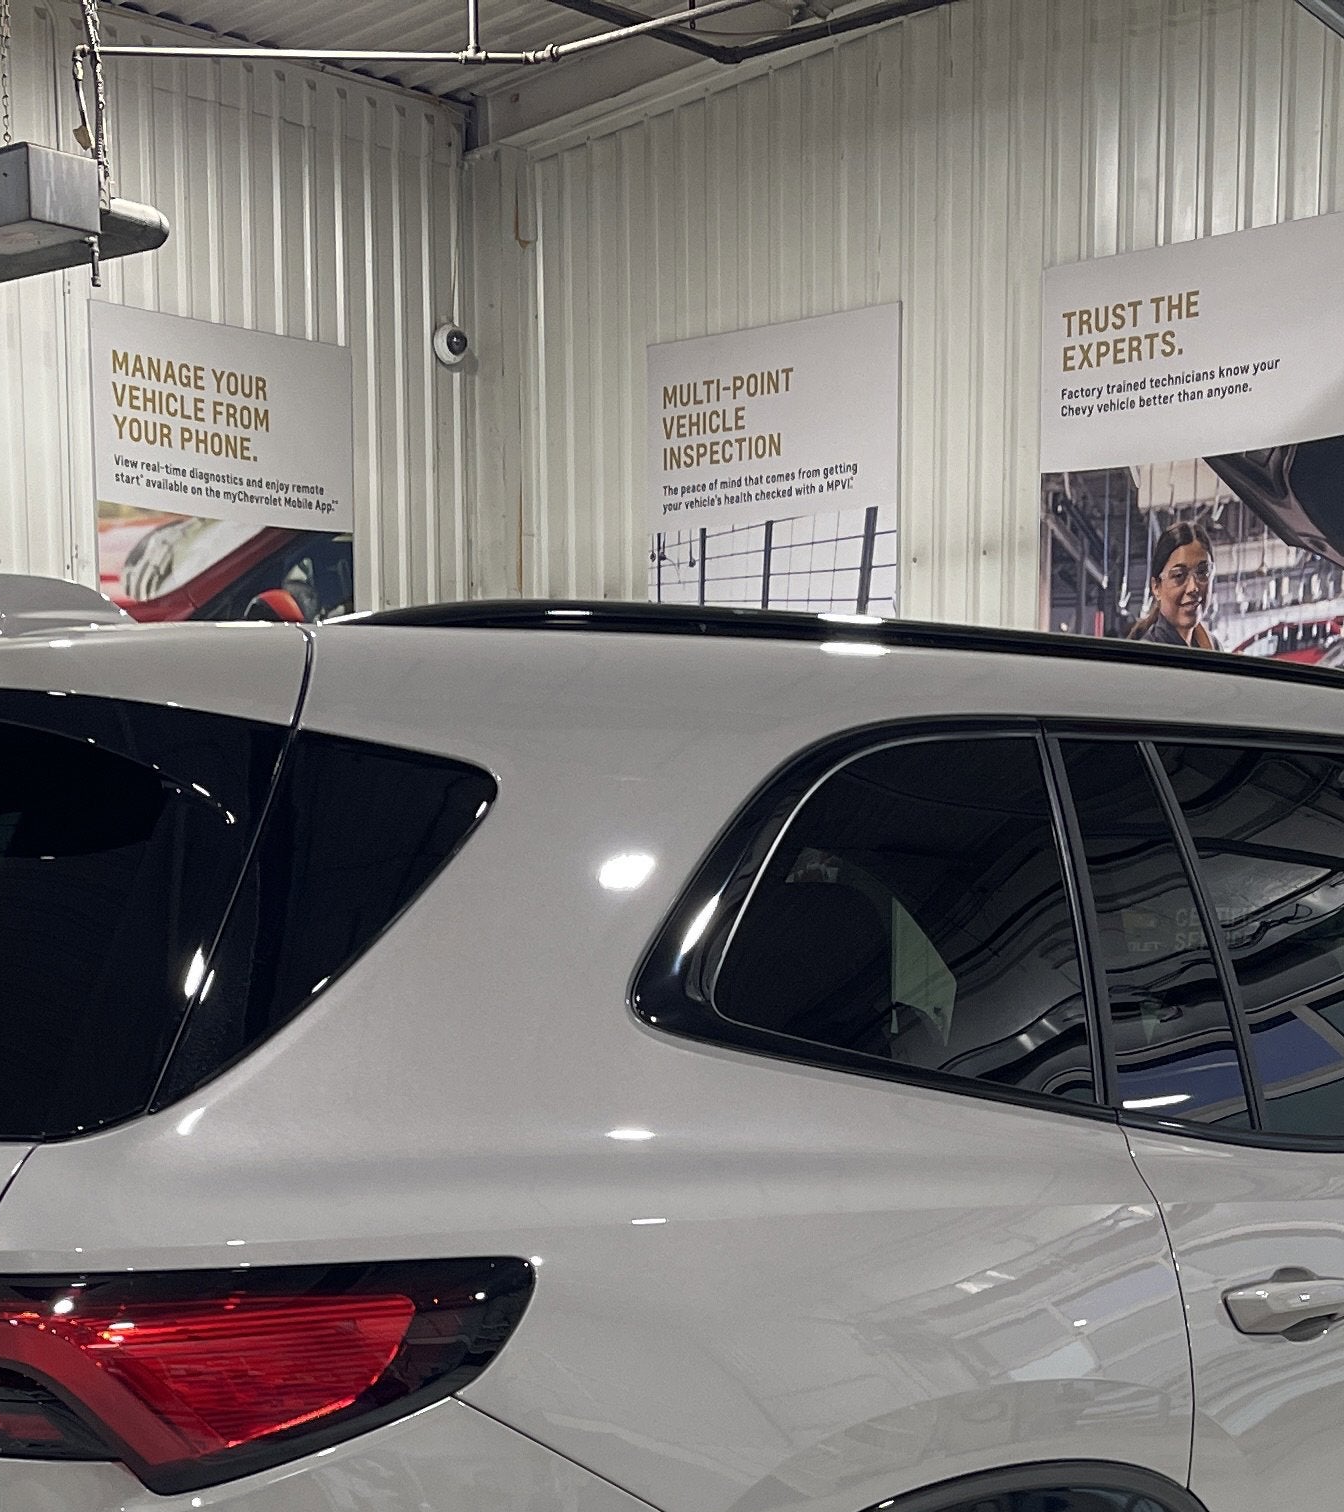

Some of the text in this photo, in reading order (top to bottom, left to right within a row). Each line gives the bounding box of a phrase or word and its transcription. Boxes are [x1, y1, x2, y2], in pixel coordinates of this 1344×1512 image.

[1062, 290, 1199, 336] TRUST THE
[1062, 331, 1183, 371] EXPERTS.
[111, 350, 267, 400] MANAGE YOUR
[662, 368, 794, 408] MULTI-POINT
[1061, 358, 1280, 400] Factory trained technicians know your
[111, 382, 270, 431] VEHICLE FROM
[1061, 382, 1252, 417] Chevy vehicle better than anyone.
[114, 415, 257, 461] YOUR PHONE.
[662, 406, 746, 439] VEHICLE
[663, 433, 781, 469] INSPECTION
[113, 453, 324, 495] View real-time diagnostics and enjoy remote
[145, 478, 188, 493] available
[190, 485, 202, 496] on
[205, 486, 221, 499] the
[223, 490, 282, 506] myChevrolet
[284, 492, 312, 510] Mobile
[662, 463, 858, 497] The peace of mind that comes from getting
[662, 501, 683, 515] your
[684, 494, 722, 509] vehicle's
[723, 490, 753, 504] health
[754, 485, 793, 501] checked
[794, 483, 816, 496] with
[817, 483, 824, 493] a
